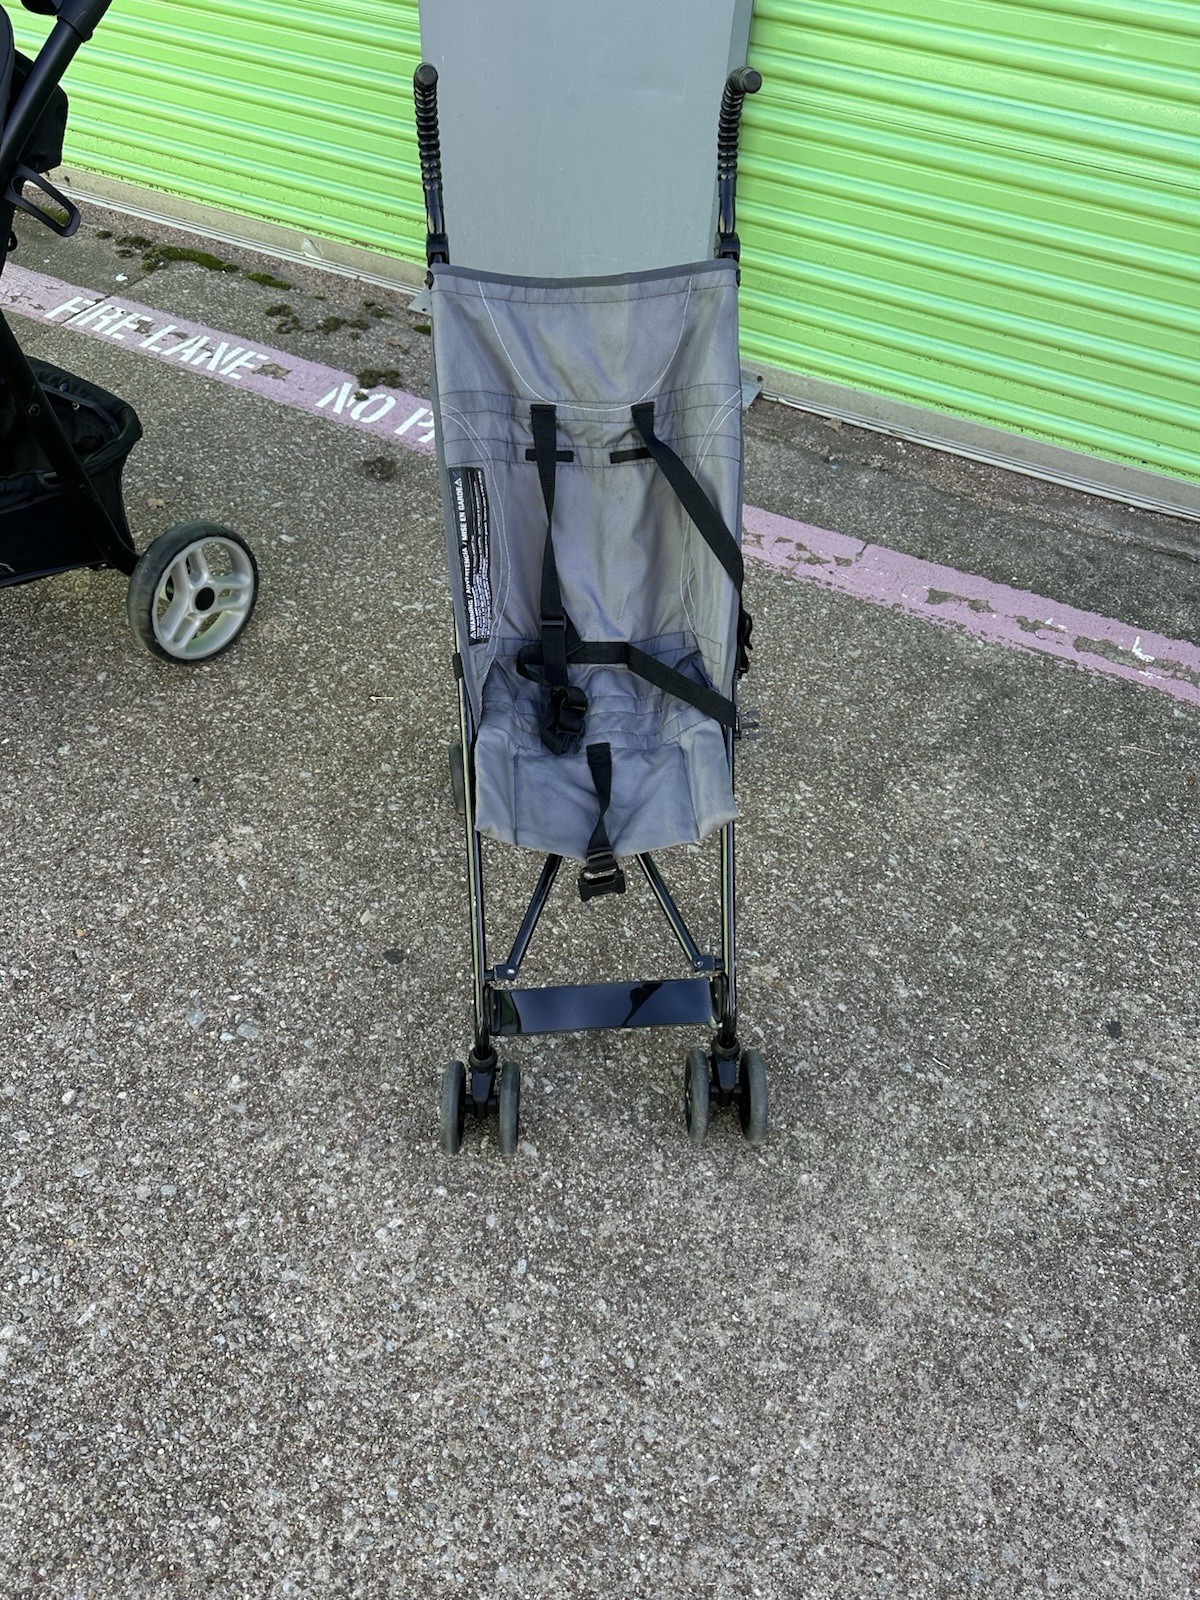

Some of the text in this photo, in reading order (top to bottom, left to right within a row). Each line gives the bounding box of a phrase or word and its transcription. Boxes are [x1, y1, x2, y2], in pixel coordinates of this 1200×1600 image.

[44, 296, 152, 341] FIRE
[138, 324, 269, 380] LANE
[315, 382, 396, 424] NO
[456, 486, 465, 510] GARDE
[459, 512, 466, 522] EN
[460, 523, 468, 541] MISE
[467, 600, 476, 632] WARNING
